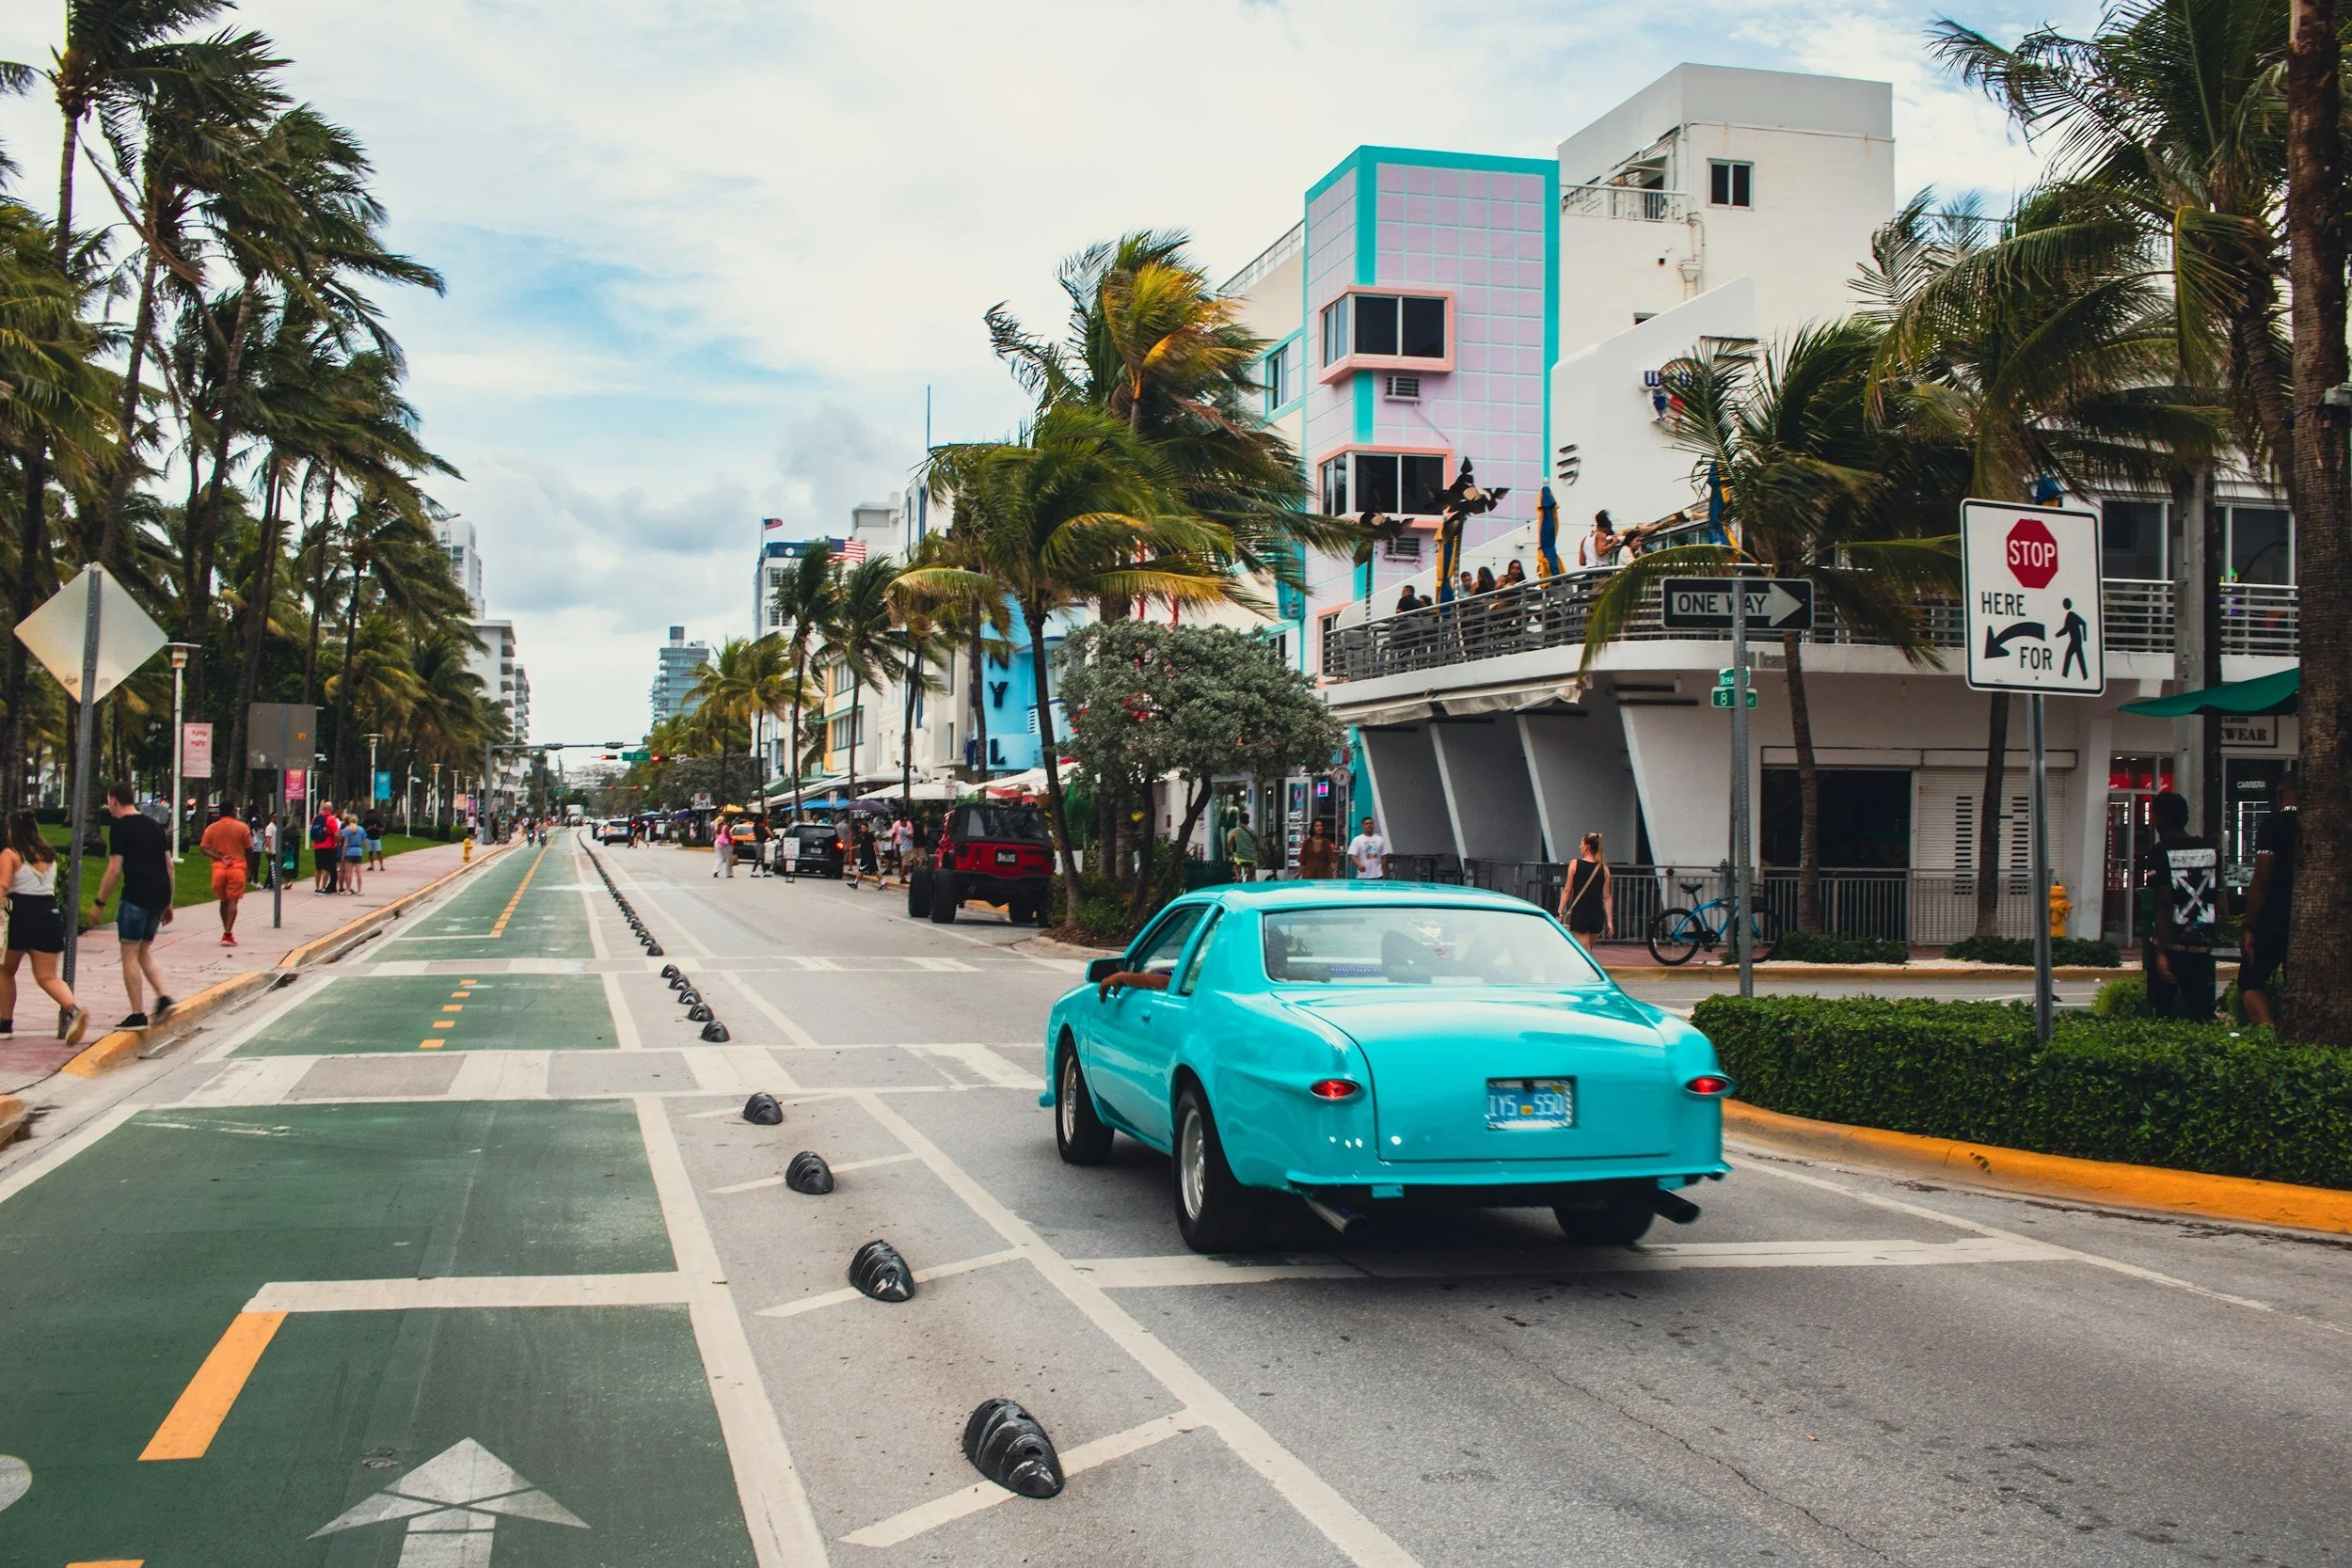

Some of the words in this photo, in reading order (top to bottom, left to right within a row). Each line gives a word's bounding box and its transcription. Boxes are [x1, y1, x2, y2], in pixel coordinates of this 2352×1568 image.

[2009, 539, 2056, 568] STOP
[1678, 594, 1719, 613] ONE
[1981, 592, 2026, 617] HERE
[2020, 646, 2052, 671] FOR
[1720, 692, 1728, 706] 8
[2220, 727, 2267, 741] WEAR
